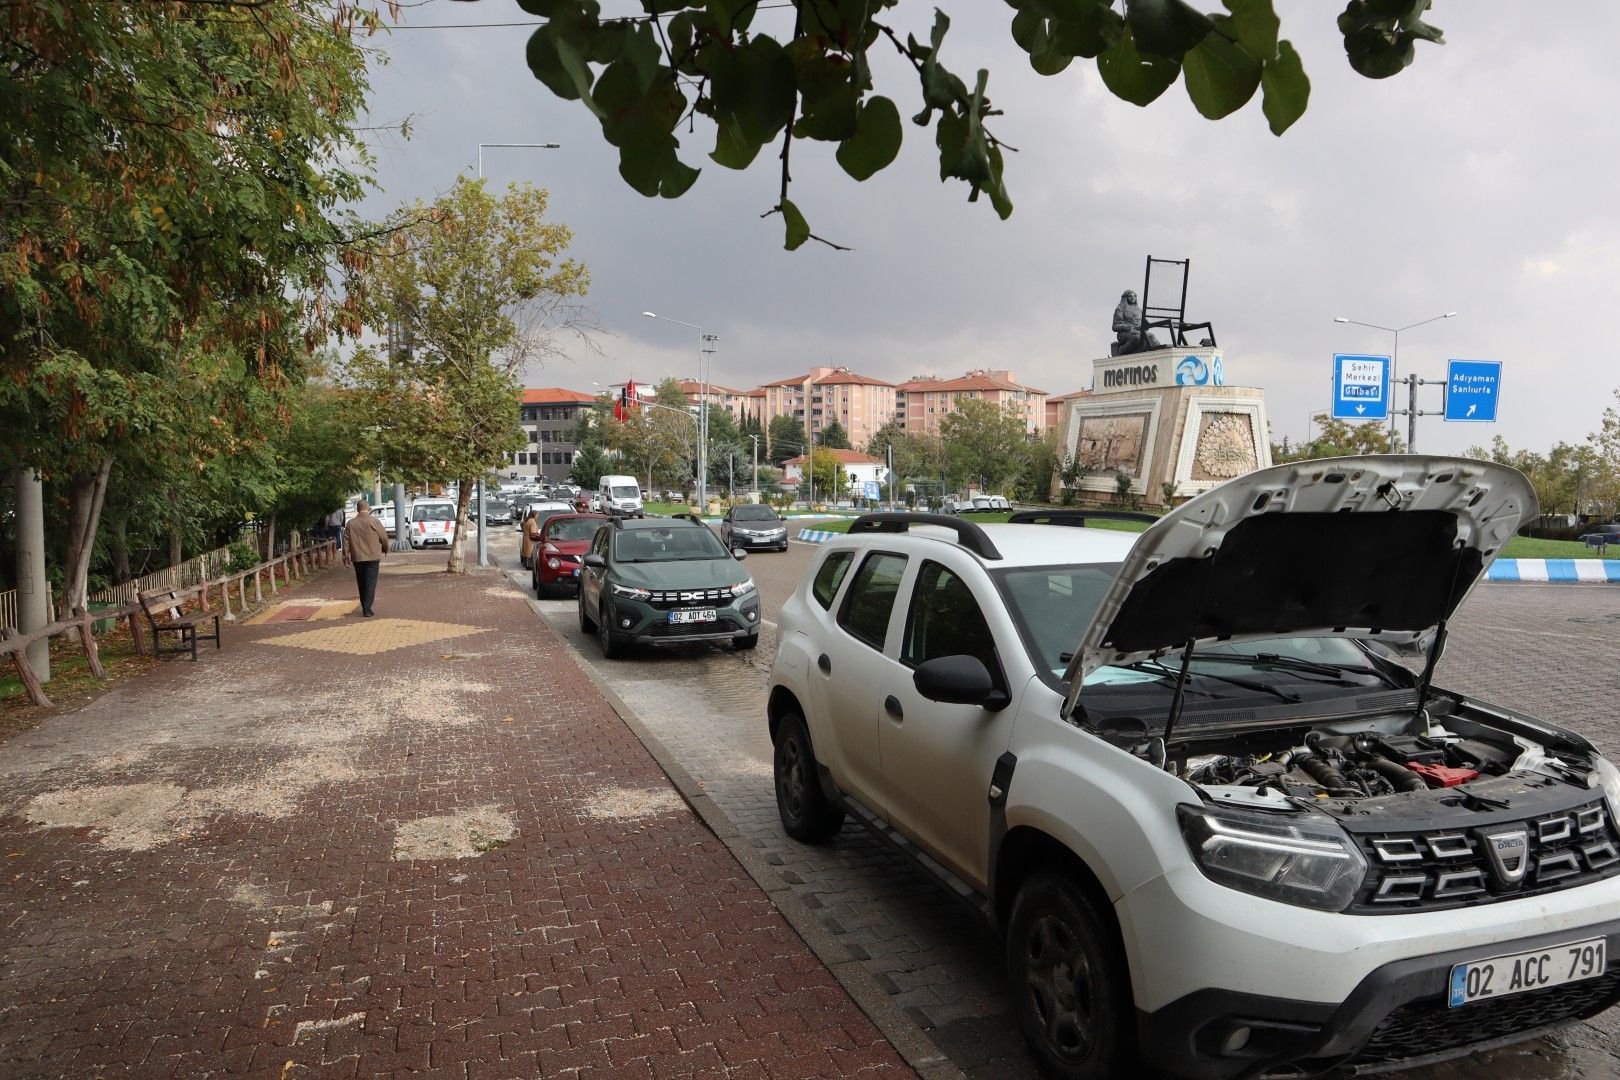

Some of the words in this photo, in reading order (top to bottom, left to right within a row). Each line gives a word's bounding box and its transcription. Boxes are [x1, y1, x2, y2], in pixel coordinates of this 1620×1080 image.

[1104, 364, 1158, 387] merinos
[1453, 374, 1495, 383] Adıyaman
[1466, 964, 1495, 998] 02
[1509, 953, 1551, 991] ACC
[1567, 943, 1604, 980] 791
[1454, 988, 1464, 998] TR
